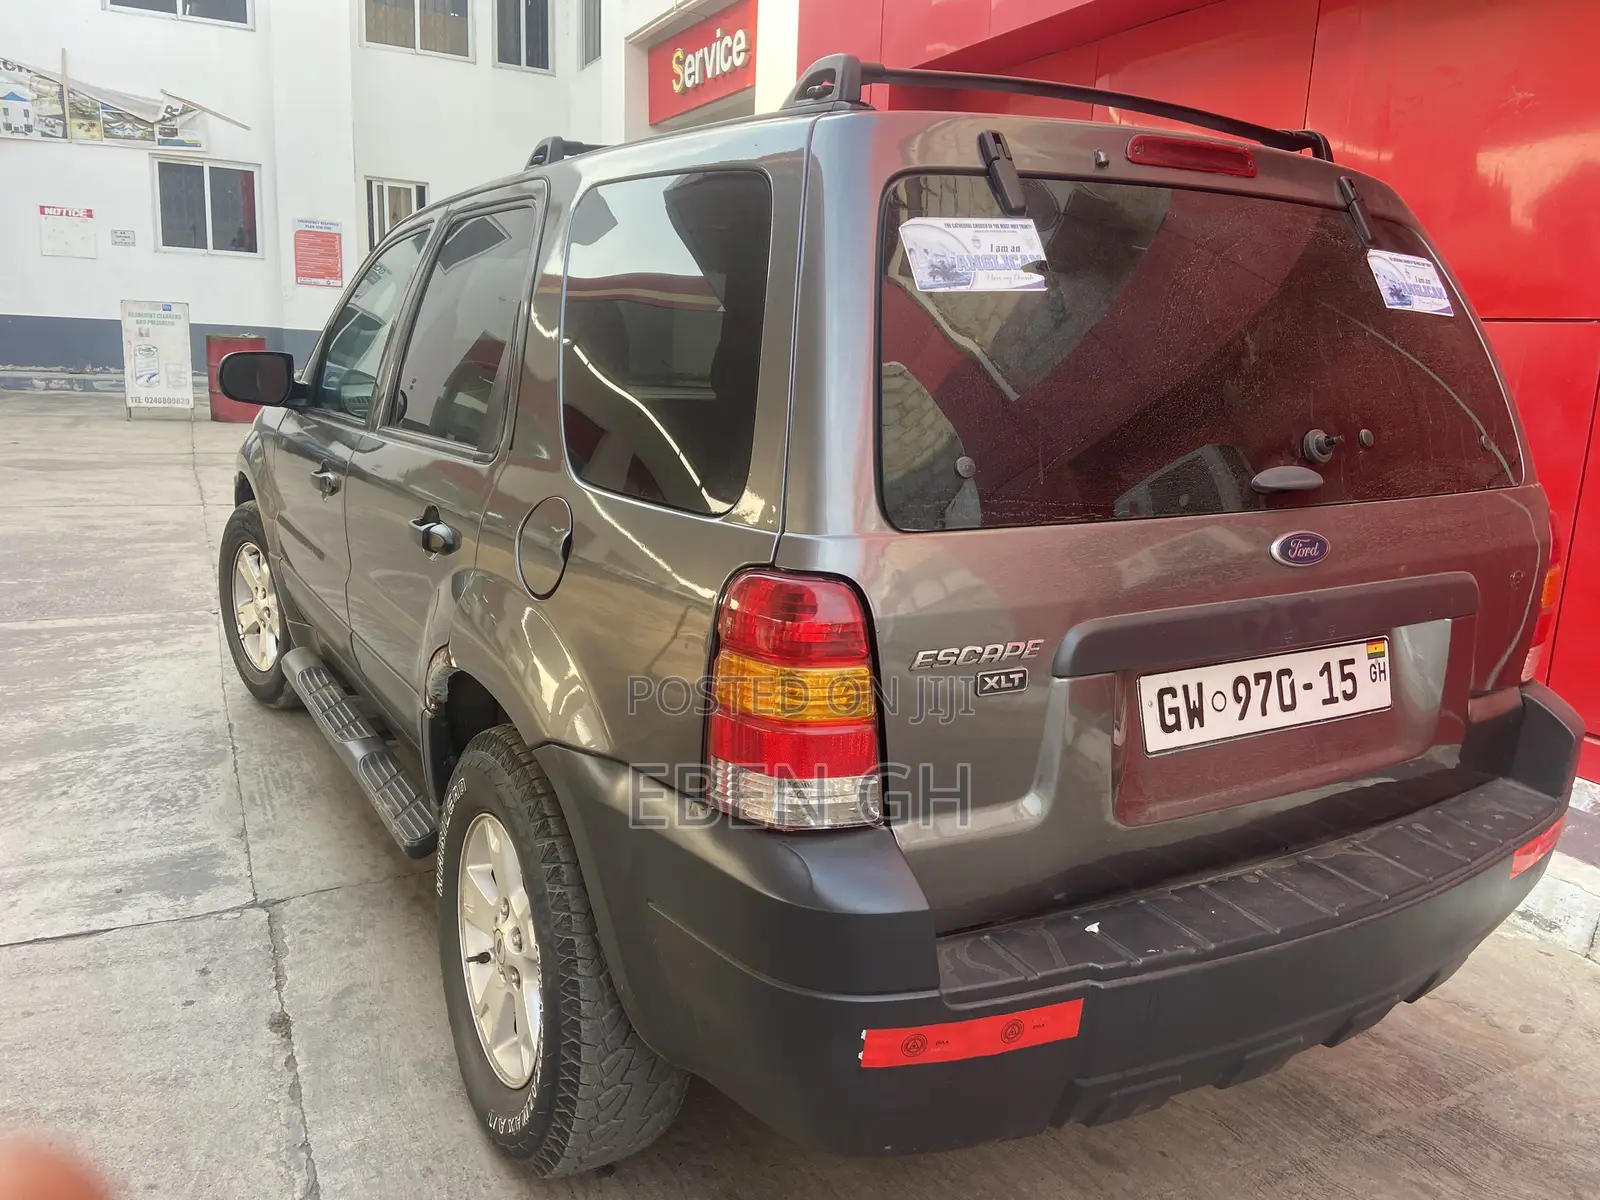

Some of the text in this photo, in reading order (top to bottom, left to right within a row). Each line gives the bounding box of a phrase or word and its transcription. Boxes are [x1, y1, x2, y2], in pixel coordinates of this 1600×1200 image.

[671, 28, 747, 94] Service
[44, 207, 87, 218] NOTICE
[990, 243, 1021, 253] I am an
[1287, 538, 1320, 558] Ford
[909, 639, 1046, 671] ESCAPE
[982, 670, 1027, 692] XLT
[1369, 662, 1387, 684] GH
[1156, 658, 1358, 734] GW 970-15
